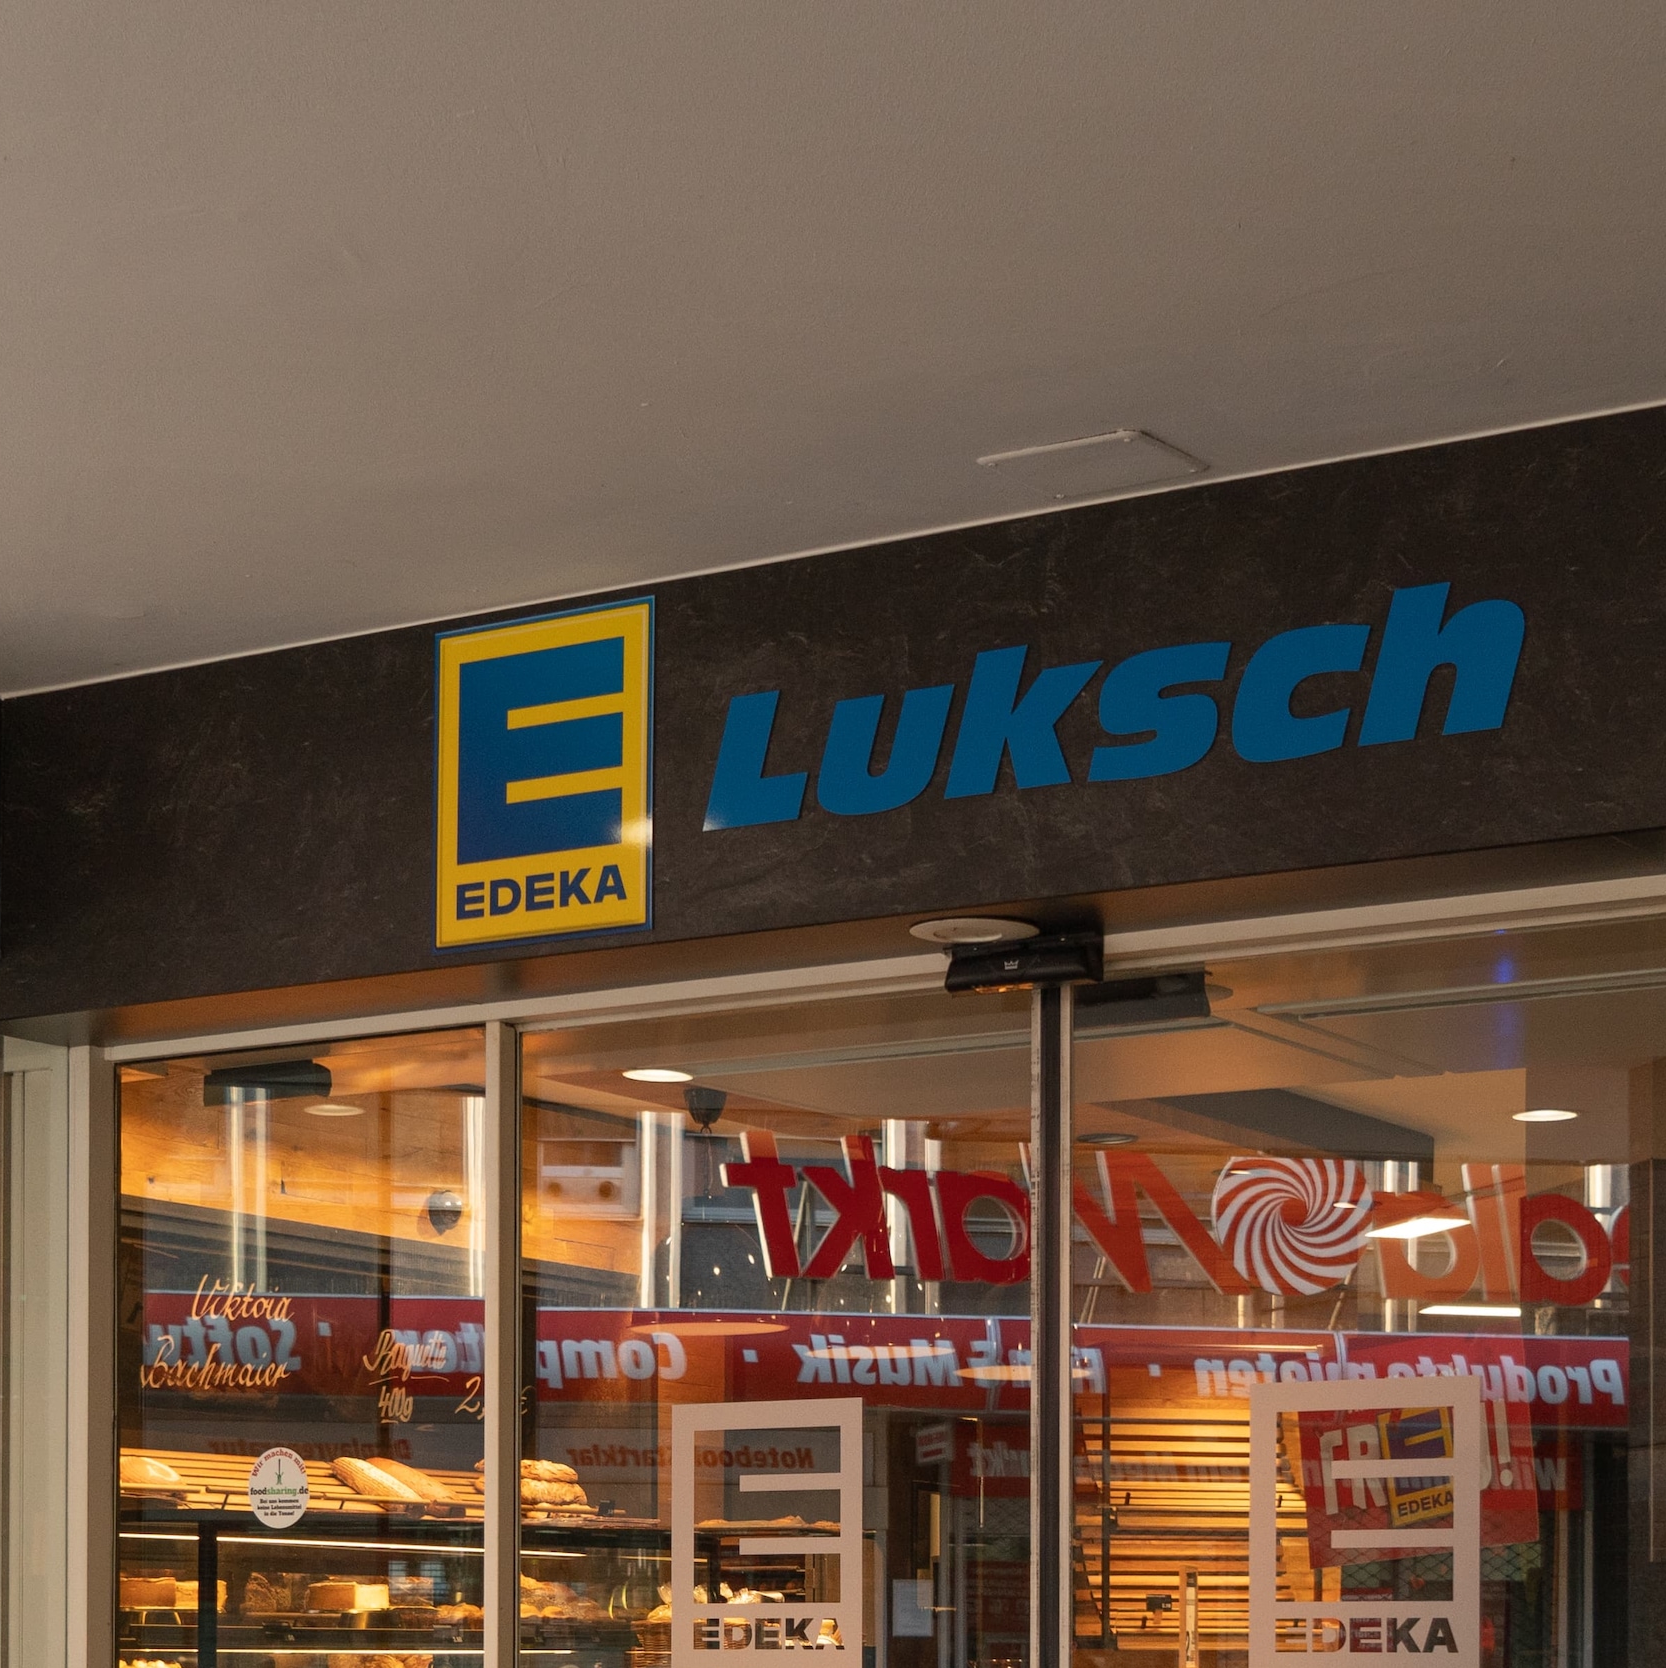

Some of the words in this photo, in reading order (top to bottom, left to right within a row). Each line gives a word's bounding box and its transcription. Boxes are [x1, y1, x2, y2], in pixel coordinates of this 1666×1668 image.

[702, 581, 1526, 832] Luksch
[455, 862, 629, 922] EDEKA
[251, 1460, 264, 1477] Wir
[264, 1448, 293, 1462] machen
[250, 1485, 309, 1497] foodsharing.de
[1397, 1489, 1454, 1517] EDEKA
[693, 1617, 846, 1651] EDEKA
[1274, 1616, 1459, 1654] EDEKA
